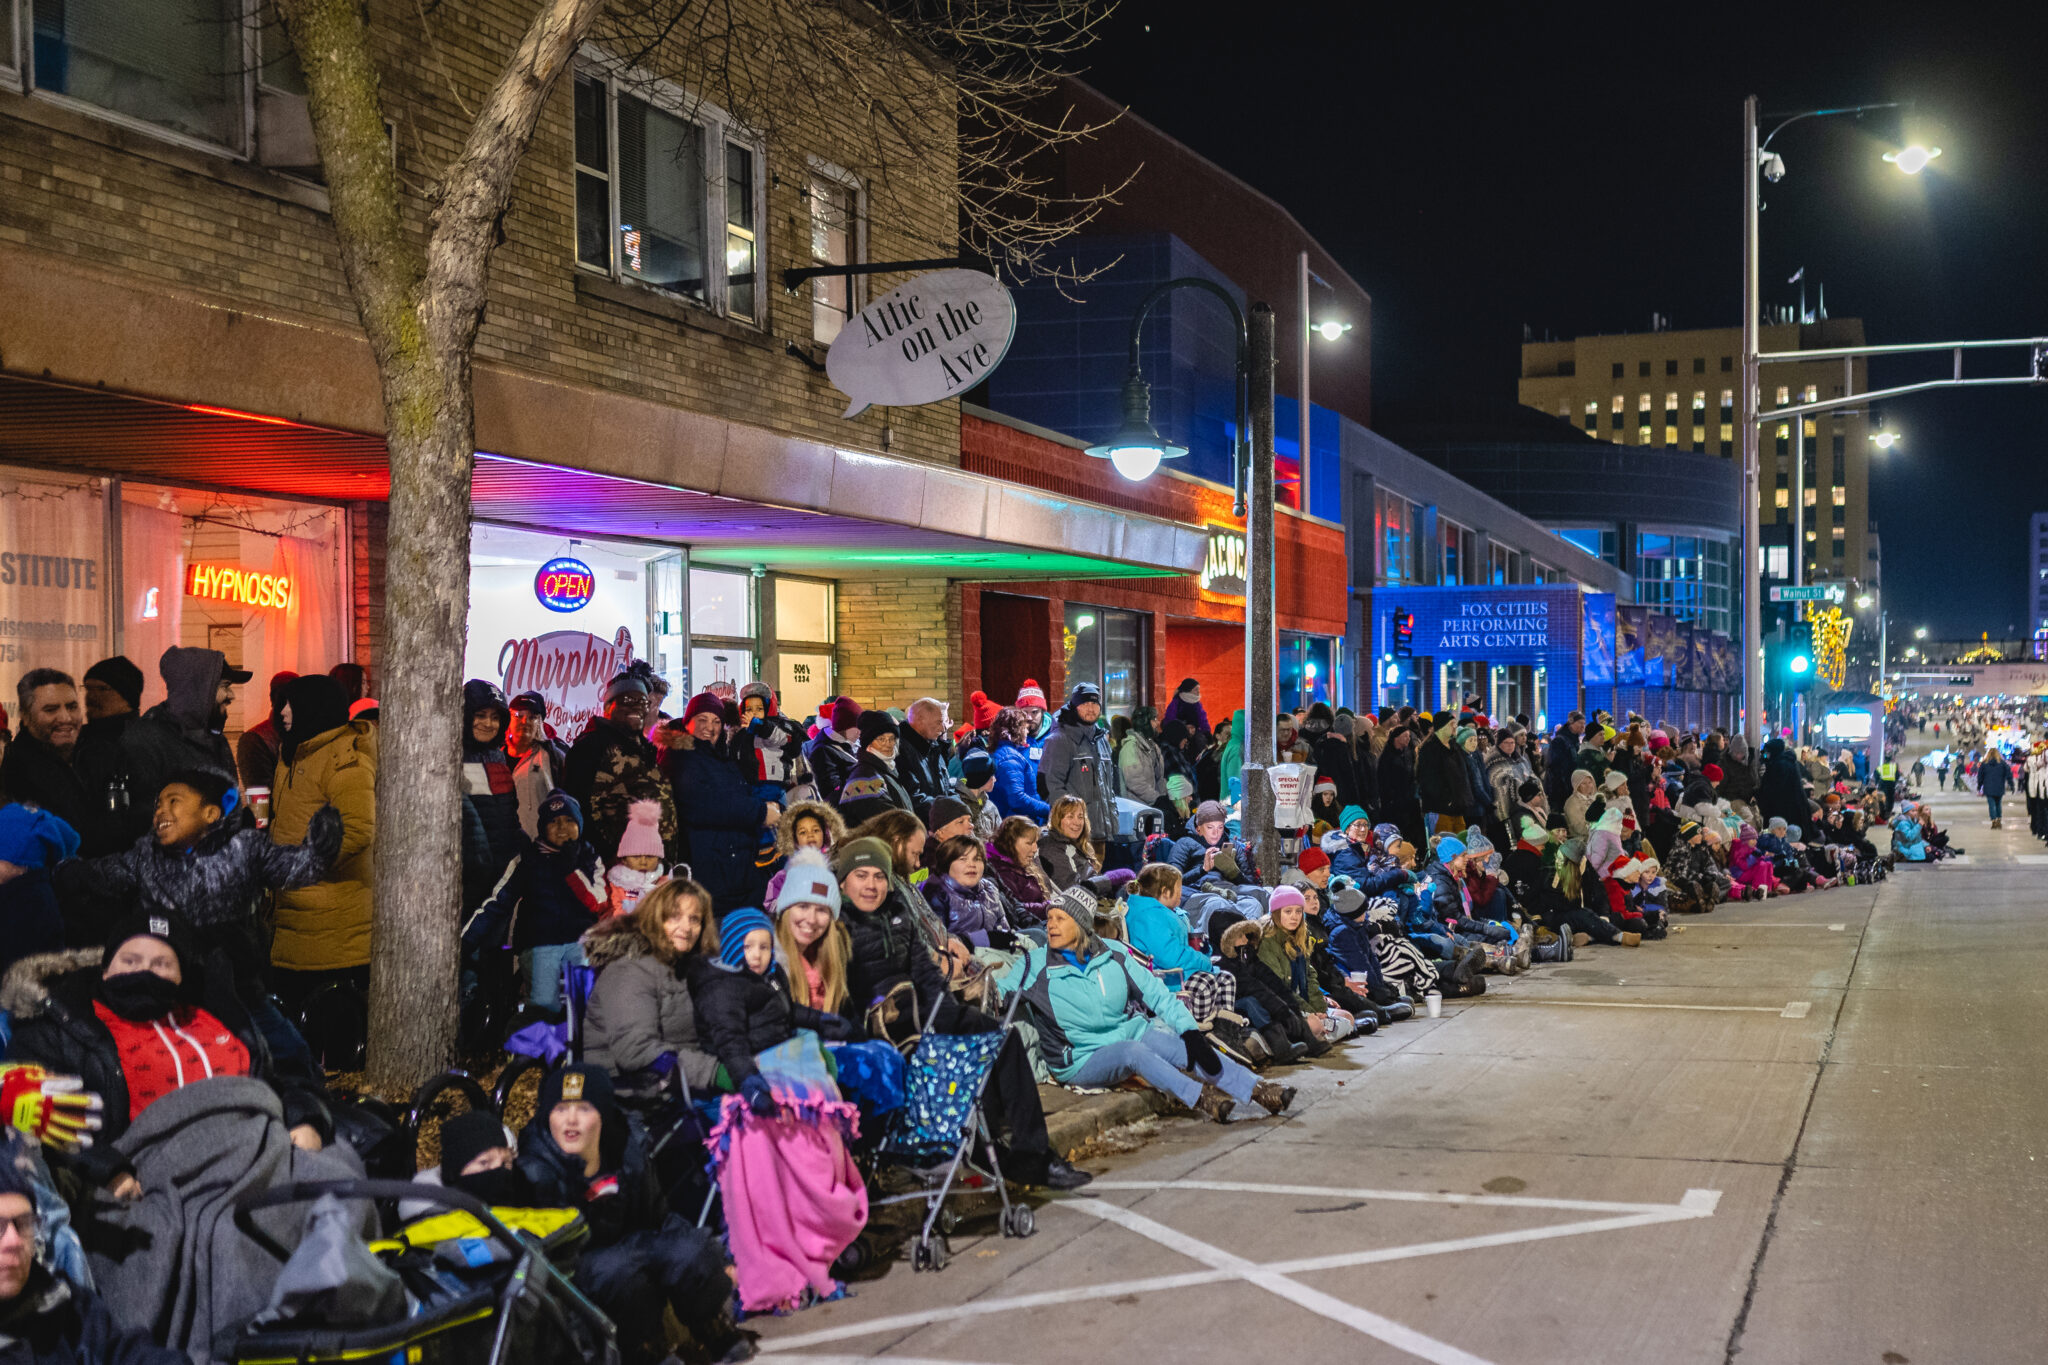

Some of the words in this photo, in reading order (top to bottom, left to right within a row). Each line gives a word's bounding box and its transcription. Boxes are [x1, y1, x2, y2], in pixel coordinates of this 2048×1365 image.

[861, 292, 926, 349] Attic
[902, 326, 938, 363] on
[935, 300, 983, 342] the
[938, 342, 991, 391] Ave
[0, 552, 97, 590] STITUTE
[1208, 535, 1247, 581] ACOC
[192, 564, 289, 609] HYPNOSIS
[544, 574, 591, 598] OPEN
[1783, 589, 1810, 598] Walnut
[1813, 588, 1821, 597] St
[1443, 618, 1548, 632] PERFORMING
[1461, 604, 1493, 616] FOX
[1496, 602, 1548, 615] CITIES
[1439, 635, 1480, 647] ARTS
[1484, 634, 1548, 647] CENTER
